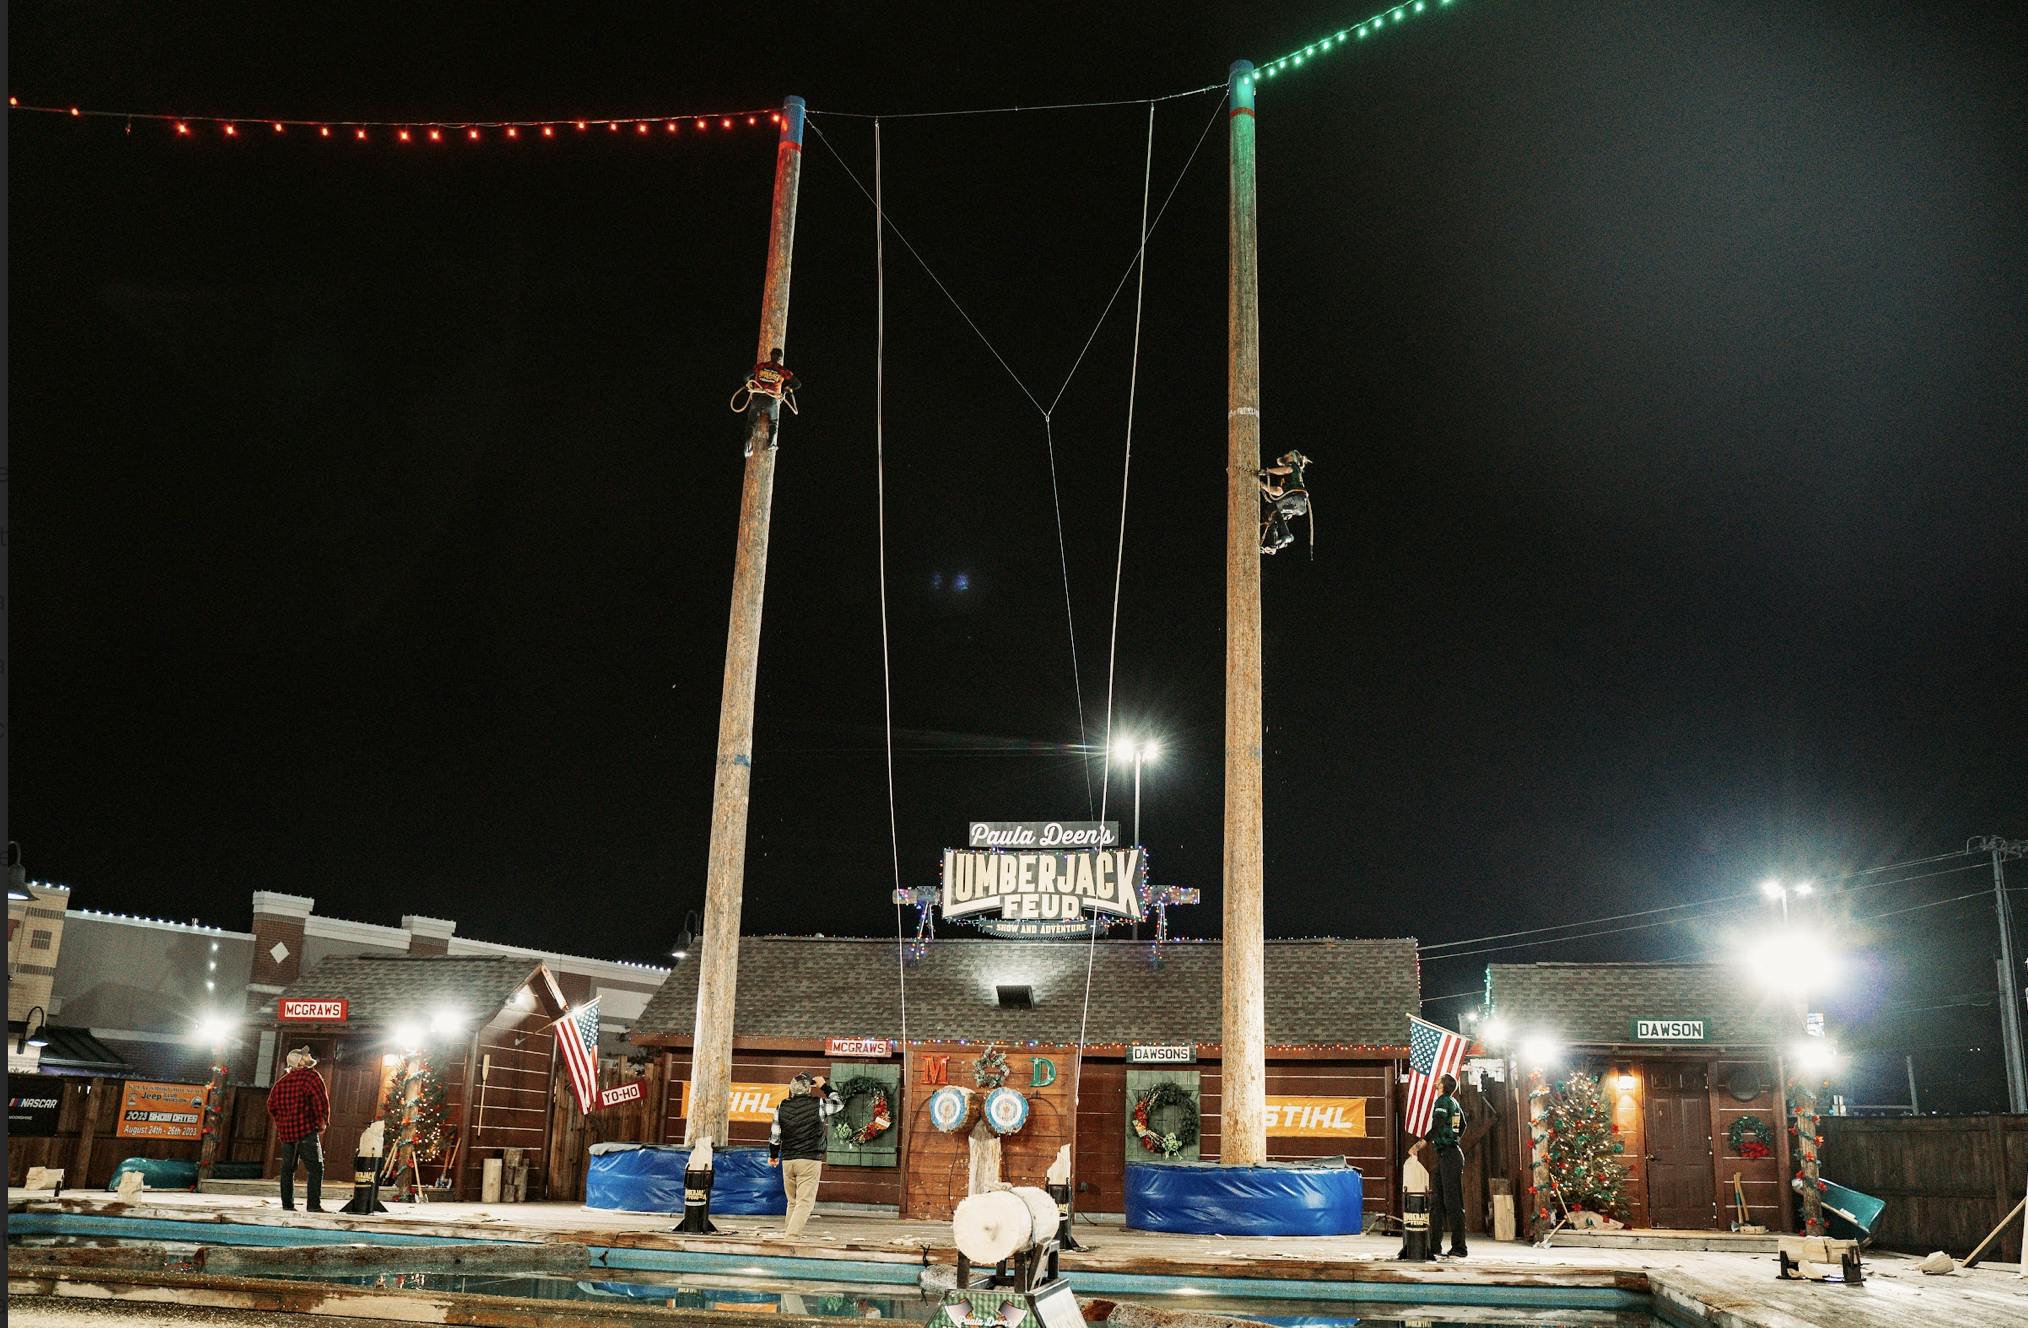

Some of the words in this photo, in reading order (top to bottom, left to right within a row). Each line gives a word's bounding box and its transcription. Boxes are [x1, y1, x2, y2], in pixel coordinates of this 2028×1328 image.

[971, 823, 1035, 846] Paula
[1039, 822, 1115, 846] Deen's
[943, 850, 1142, 919] LUMBERJACK
[1001, 893, 1082, 919] FEUD
[996, 923, 1020, 933] SHOW
[1021, 924, 1037, 934] AND
[1039, 923, 1087, 934] ADVENTURE
[286, 1003, 340, 1016] MCGRAWS
[1639, 1023, 1702, 1037] DAWSON
[832, 1040, 885, 1054] MCGRAWS
[1135, 1048, 1189, 1060] DAWSONS
[921, 1055, 950, 1085] M
[1030, 1057, 1057, 1087] D
[141, 1092, 162, 1101] Jeep
[604, 1086, 638, 1103] YO-HO
[20, 1098, 58, 1109] NASCAR
[728, 1091, 778, 1113] IHL
[126, 1111, 148, 1121] 2023
[148, 1112, 172, 1122] SHOW
[172, 1114, 198, 1123] DATES
[1263, 1105, 1353, 1129] STIHL
[124, 1124, 147, 1136] August
